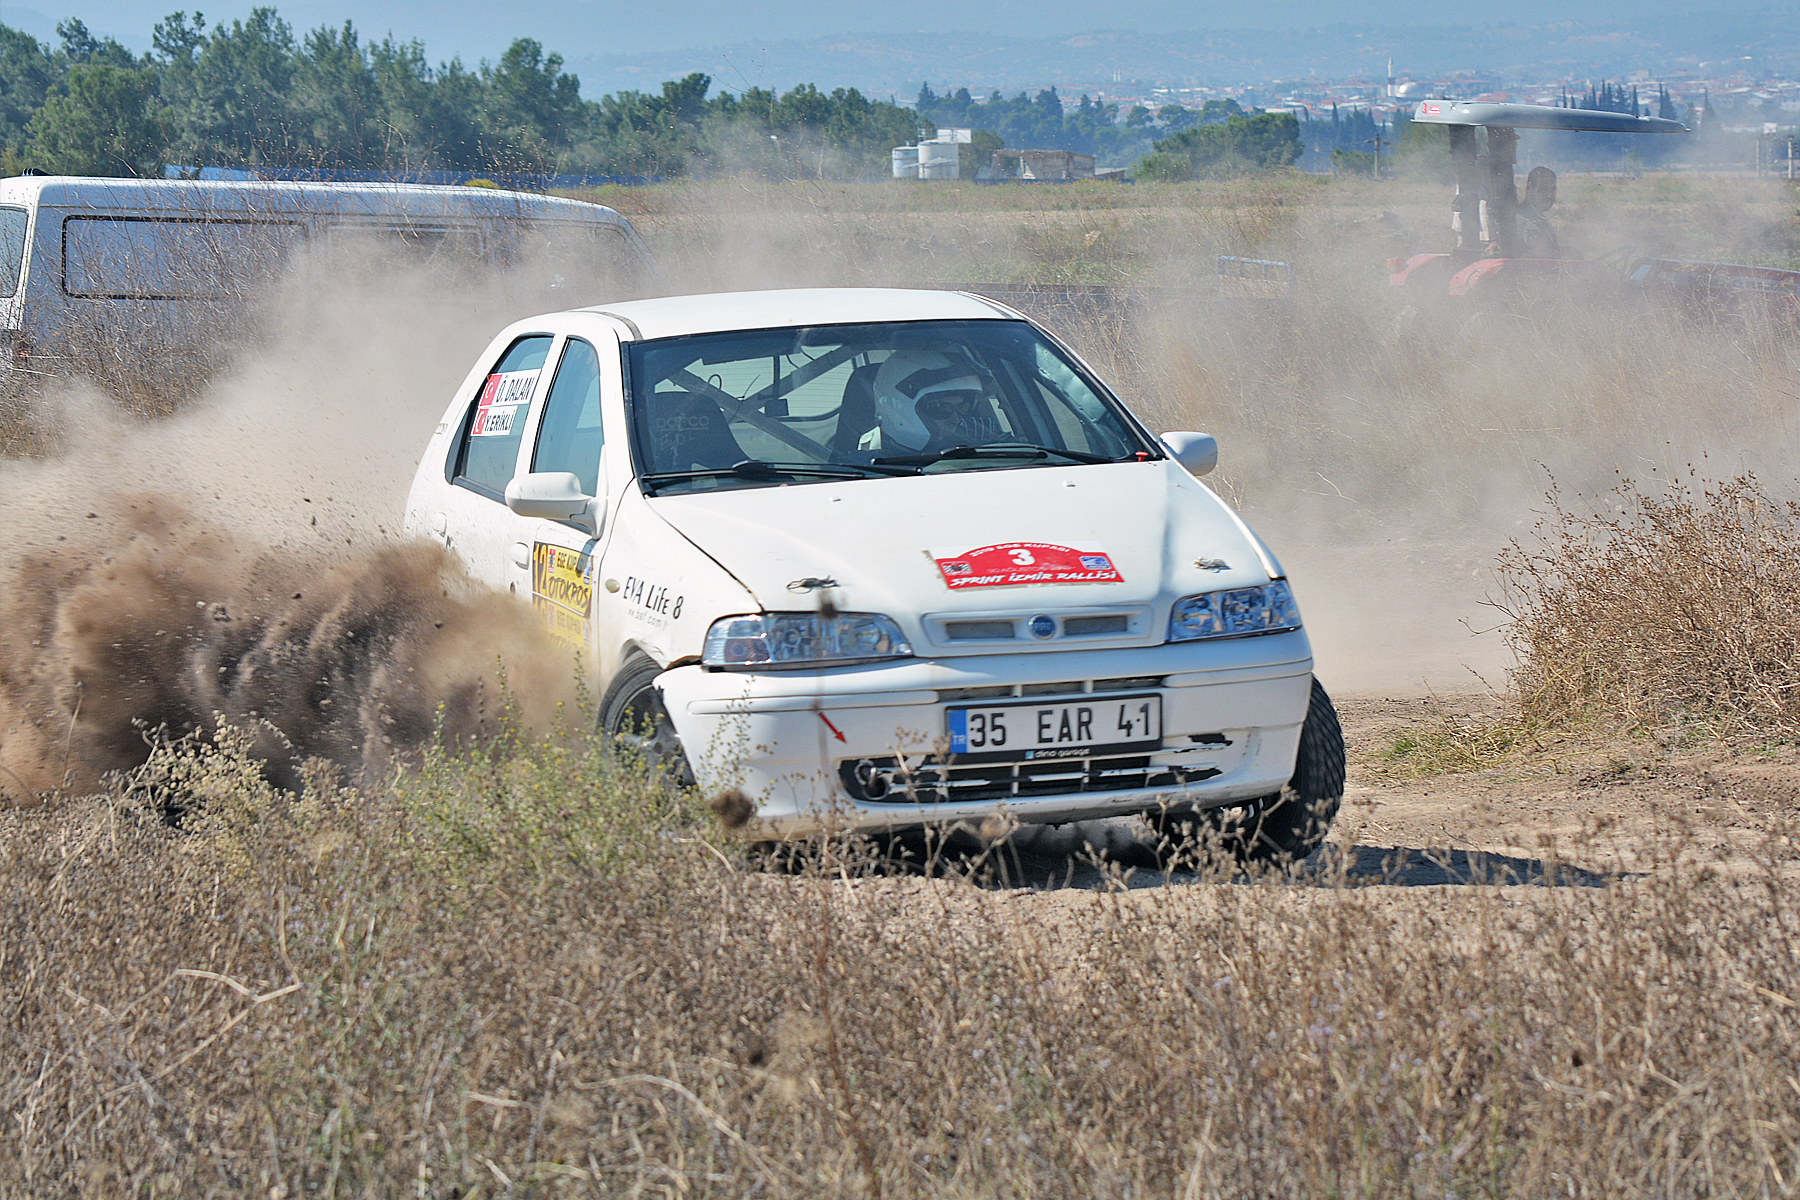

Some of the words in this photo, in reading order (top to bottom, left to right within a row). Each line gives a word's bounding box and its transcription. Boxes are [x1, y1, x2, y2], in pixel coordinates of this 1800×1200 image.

[504, 376, 535, 402] DALAN
[556, 551, 567, 569] EGE
[1007, 549, 1036, 566] 3
[533, 543, 548, 595] 12
[949, 574, 1006, 587] SPRINT
[1008, 571, 1054, 582] İZMİR
[1056, 570, 1117, 580] RALLİSİ
[623, 576, 645, 605] EVA
[672, 595, 684, 620] 8
[970, 712, 1006, 748] 35
[1037, 706, 1093, 744] EAR
[1117, 702, 1151, 737] 41
[952, 734, 967, 745] TR
[1058, 747, 1091, 759] garage
